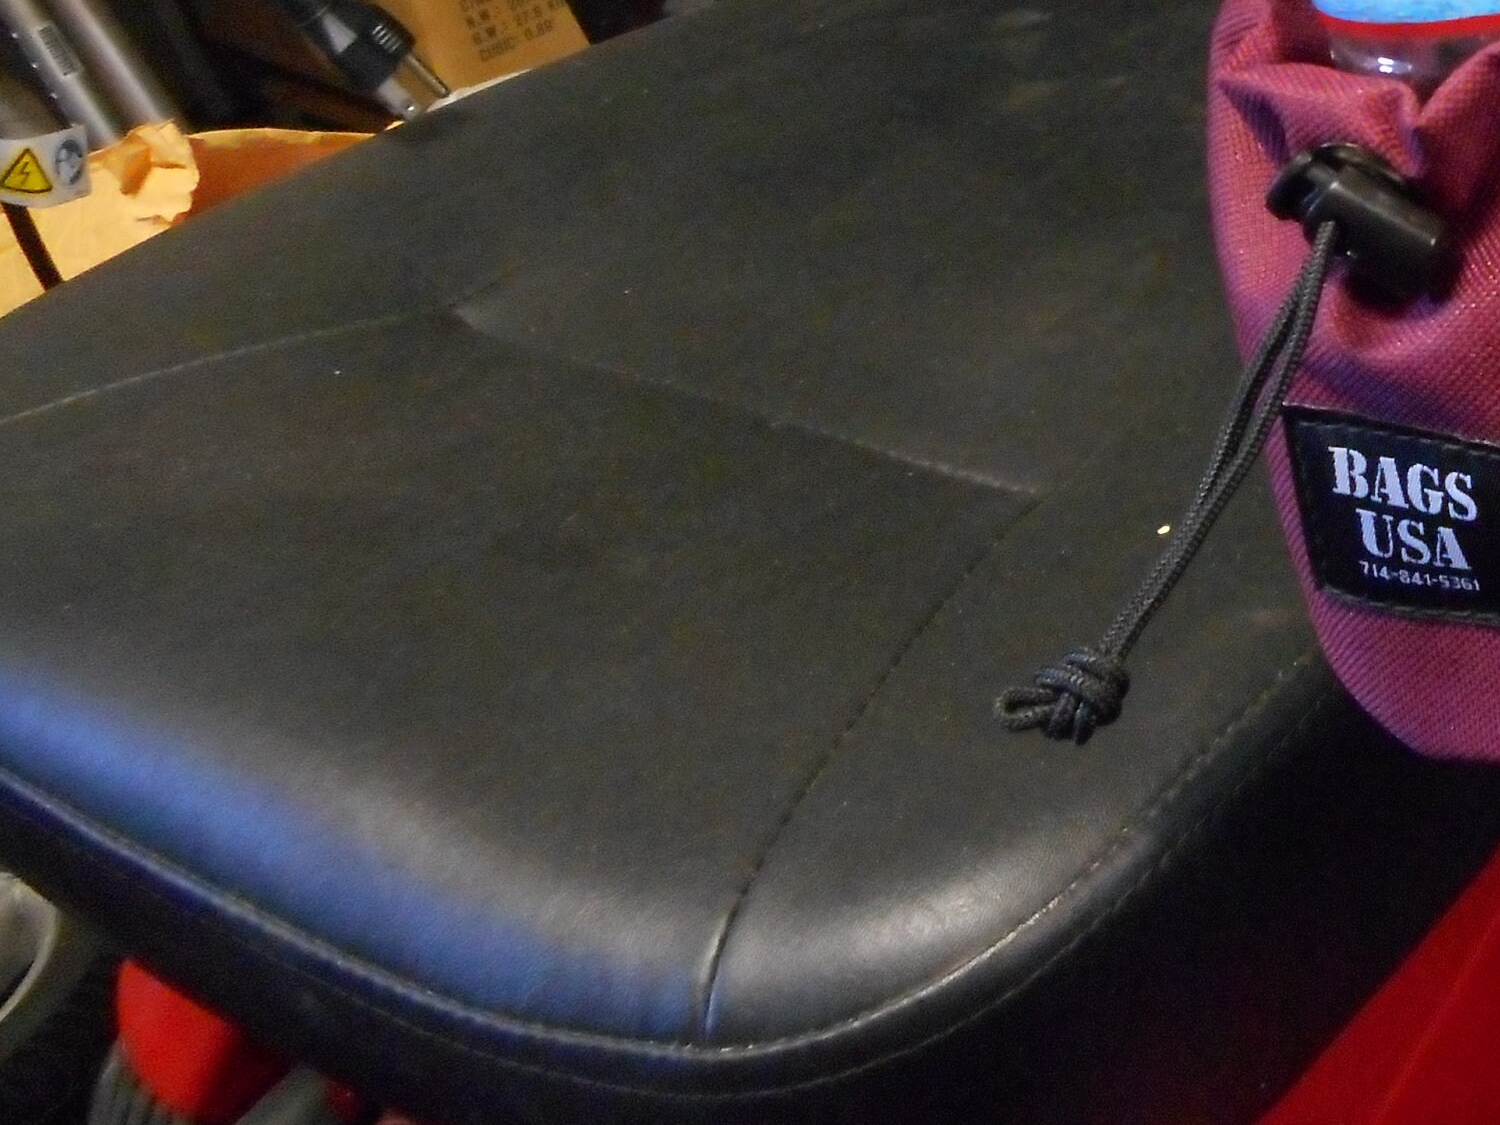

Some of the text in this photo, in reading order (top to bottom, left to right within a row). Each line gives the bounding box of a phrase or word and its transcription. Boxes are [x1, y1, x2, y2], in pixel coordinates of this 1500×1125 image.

[1327, 446, 1478, 522] BAGS
[1355, 508, 1472, 571] USA
[1358, 560, 1481, 592] 714-841-5361
